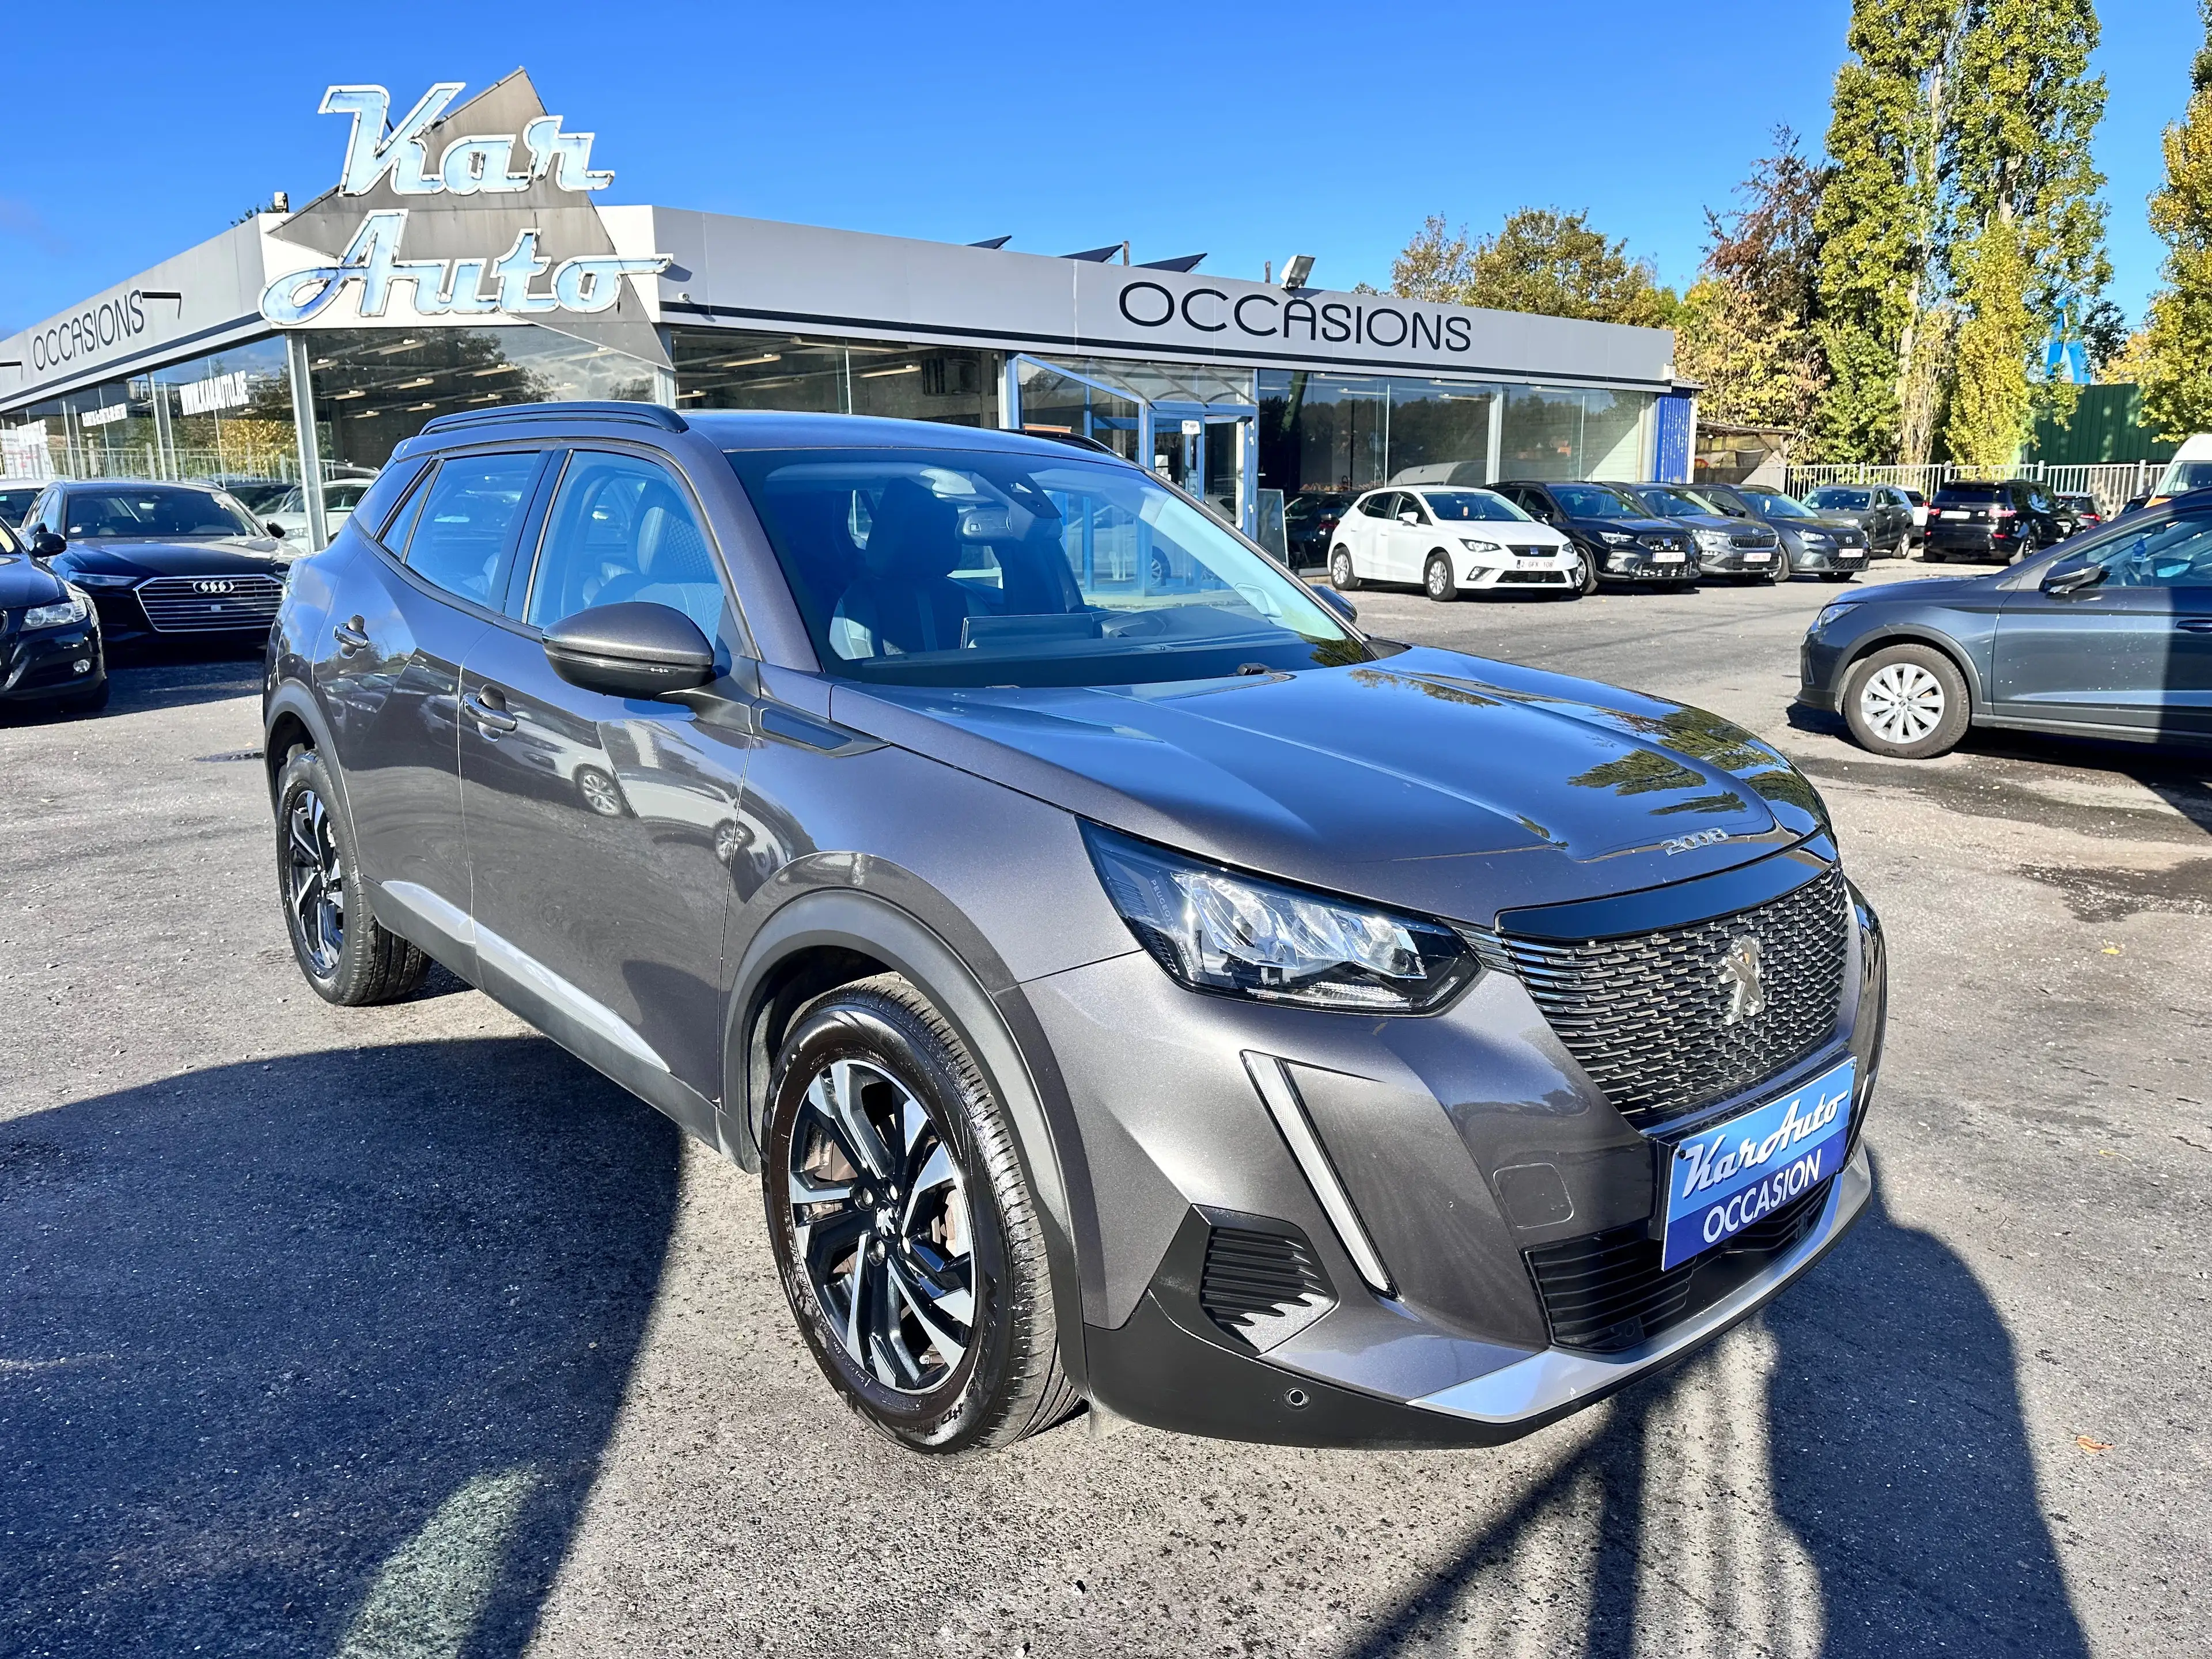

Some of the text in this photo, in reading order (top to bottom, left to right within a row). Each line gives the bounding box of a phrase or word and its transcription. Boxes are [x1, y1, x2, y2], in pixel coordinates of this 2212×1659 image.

[318, 82, 615, 197] Kar
[257, 209, 674, 325] Auto
[33, 289, 145, 371] OCCASIONS
[1119, 281, 1471, 352] OCCASIONS
[1660, 827, 1729, 857] 2008
[1151, 878, 1174, 925] PEUGEOT
[1702, 1148, 1822, 1238] OCCASION
